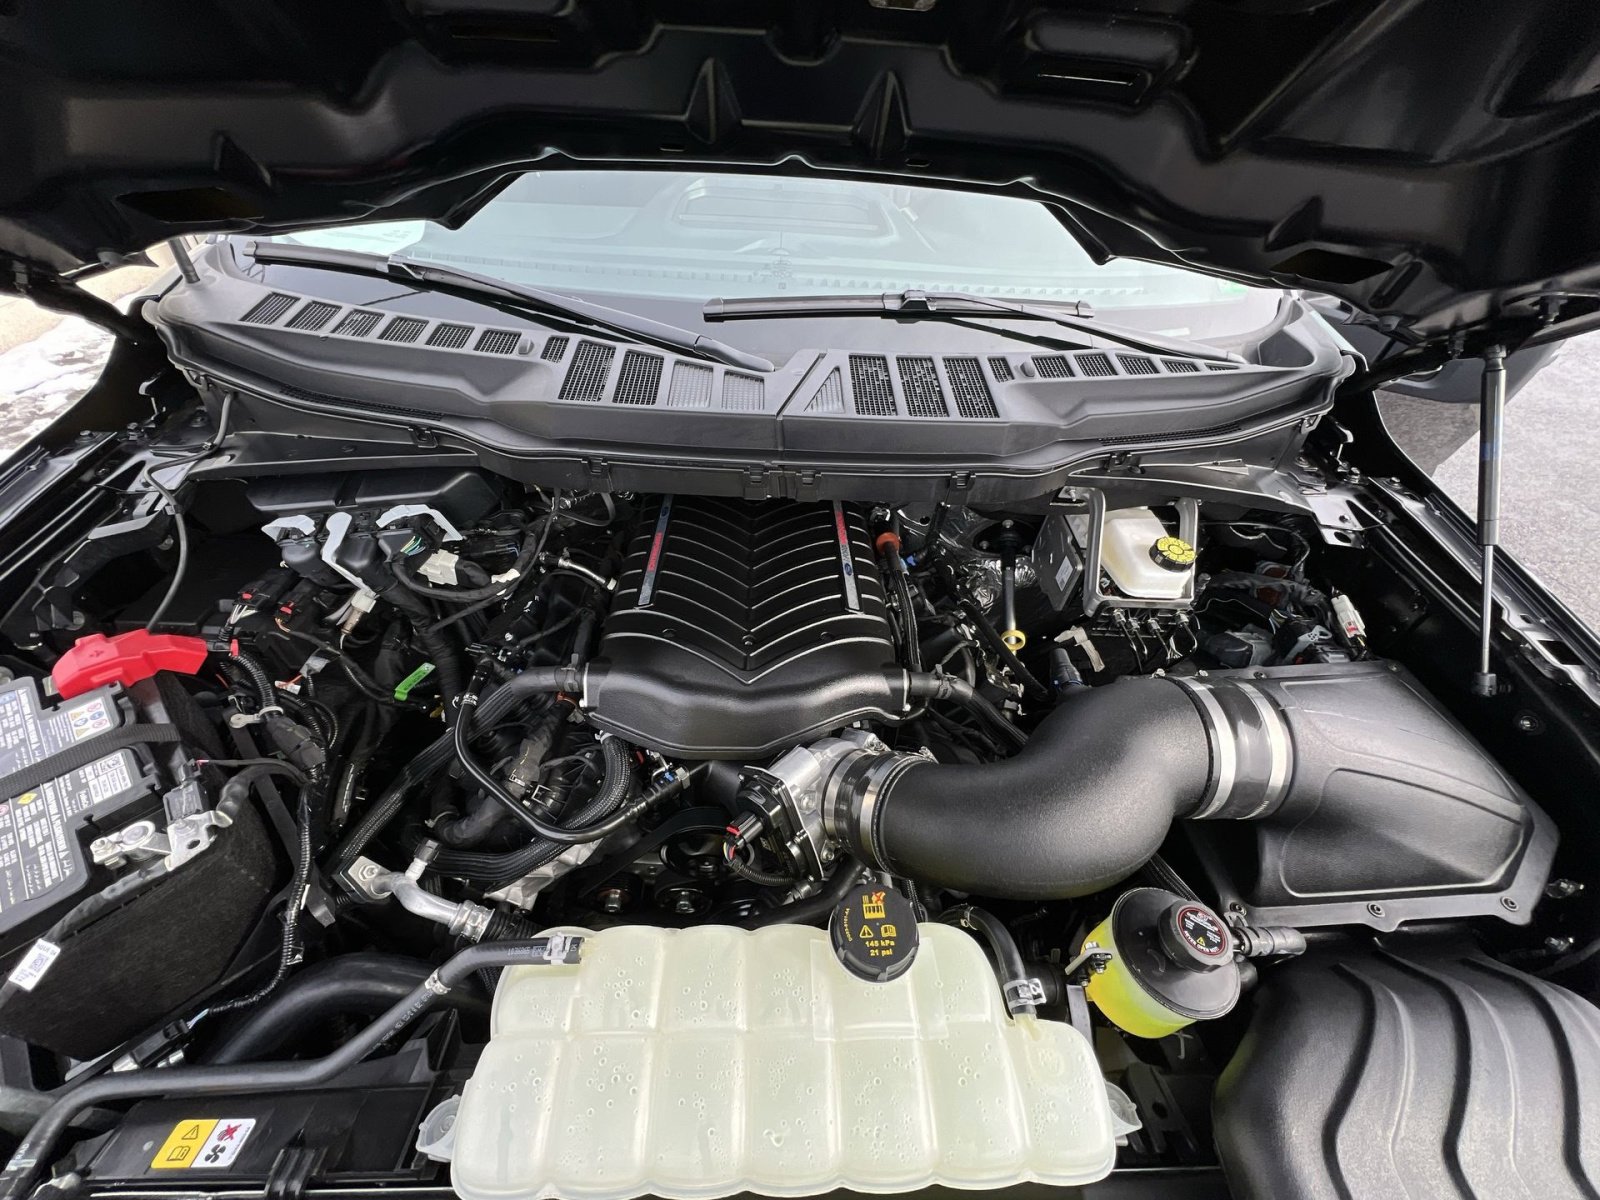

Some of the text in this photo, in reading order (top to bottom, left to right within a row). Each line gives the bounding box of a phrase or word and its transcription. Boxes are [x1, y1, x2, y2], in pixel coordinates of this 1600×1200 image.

[865, 940, 879, 948] 145
[1183, 930, 1197, 946] NEVER
[1196, 944, 1210, 953] OPEN
[881, 948, 893, 957] psi
[15, 1143, 30, 1160] RAD
